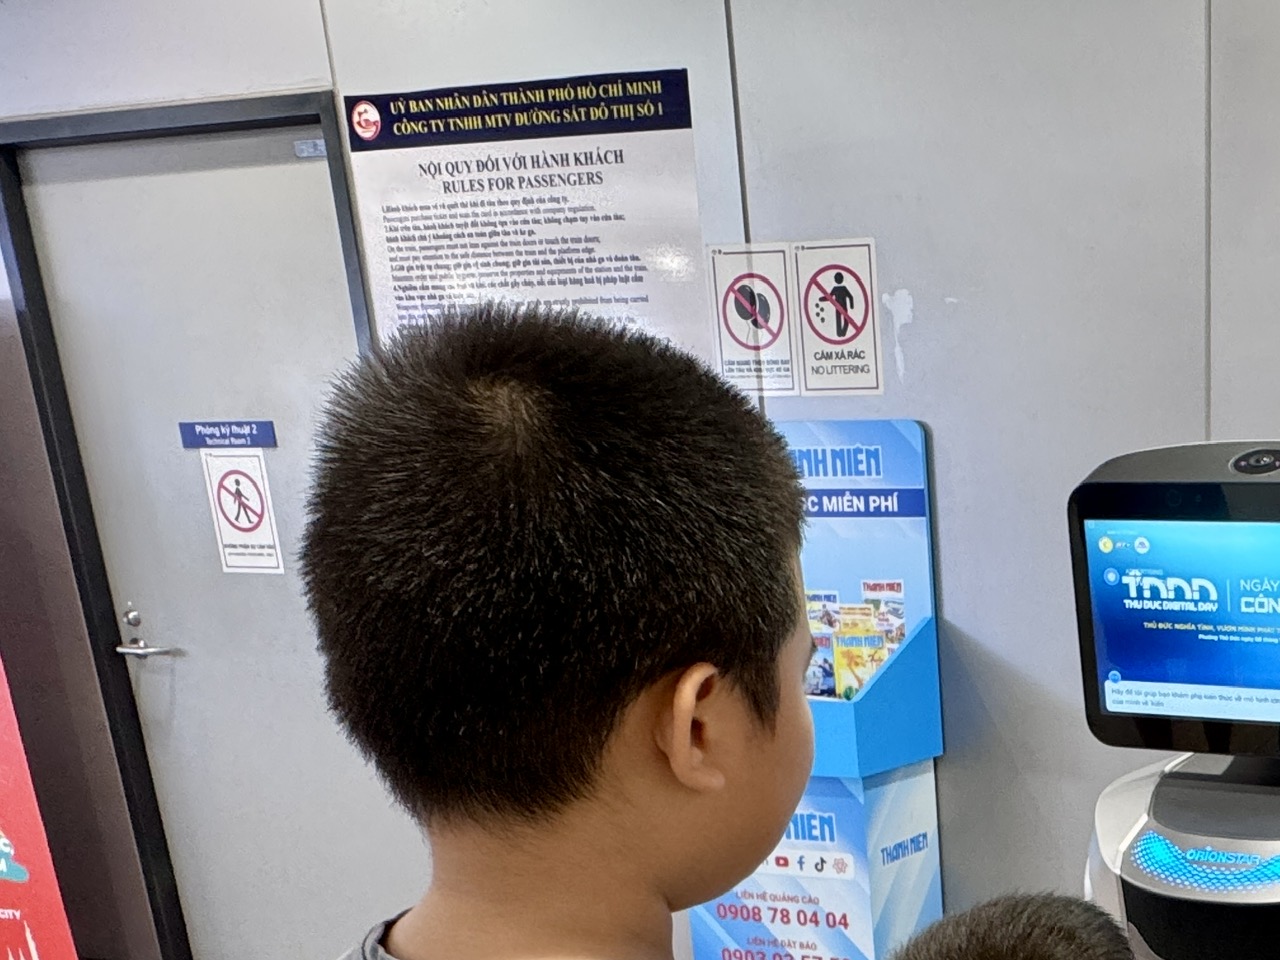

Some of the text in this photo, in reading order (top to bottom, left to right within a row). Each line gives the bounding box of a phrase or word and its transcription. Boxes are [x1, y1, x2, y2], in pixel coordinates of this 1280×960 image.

[409, 99, 432, 113] BAN
[436, 92, 470, 111] NHÂN
[473, 90, 498, 108] DÂN
[500, 87, 544, 105] THÀNH
[548, 83, 574, 101] PHỐ
[577, 82, 596, 99] HỒ
[599, 79, 623, 98] CHÍ
[626, 80, 662, 95] MINH
[393, 117, 428, 135] CÔNG
[429, 119, 446, 132] TY
[448, 116, 482, 131] TNHH
[484, 113, 511, 129] MTV
[611, 104, 634, 121] THỊ
[637, 99, 654, 116] SỐ
[658, 102, 663, 115] 1
[418, 146, 624, 178] NỘI QUY ĐỐI VỚI HÀNH KHÁCH
[443, 171, 603, 194] RULES FOR PASSENGERS
[814, 348, 865, 360] CẤM XẢ RÁC
[811, 364, 870, 375] NO LITTERING
[195, 424, 257, 436] Phòng kỹ thuật 2
[830, 444, 882, 477] NIÊN
[802, 490, 898, 512] C MIỄN PHÍ
[1240, 577, 1280, 592] NGÀY
[1186, 847, 1260, 866] ORIONSTAR
[736, 890, 819, 905] LIÊN HỆ QUẢNG CÁO
[717, 903, 849, 930] 0908 78 04 04
